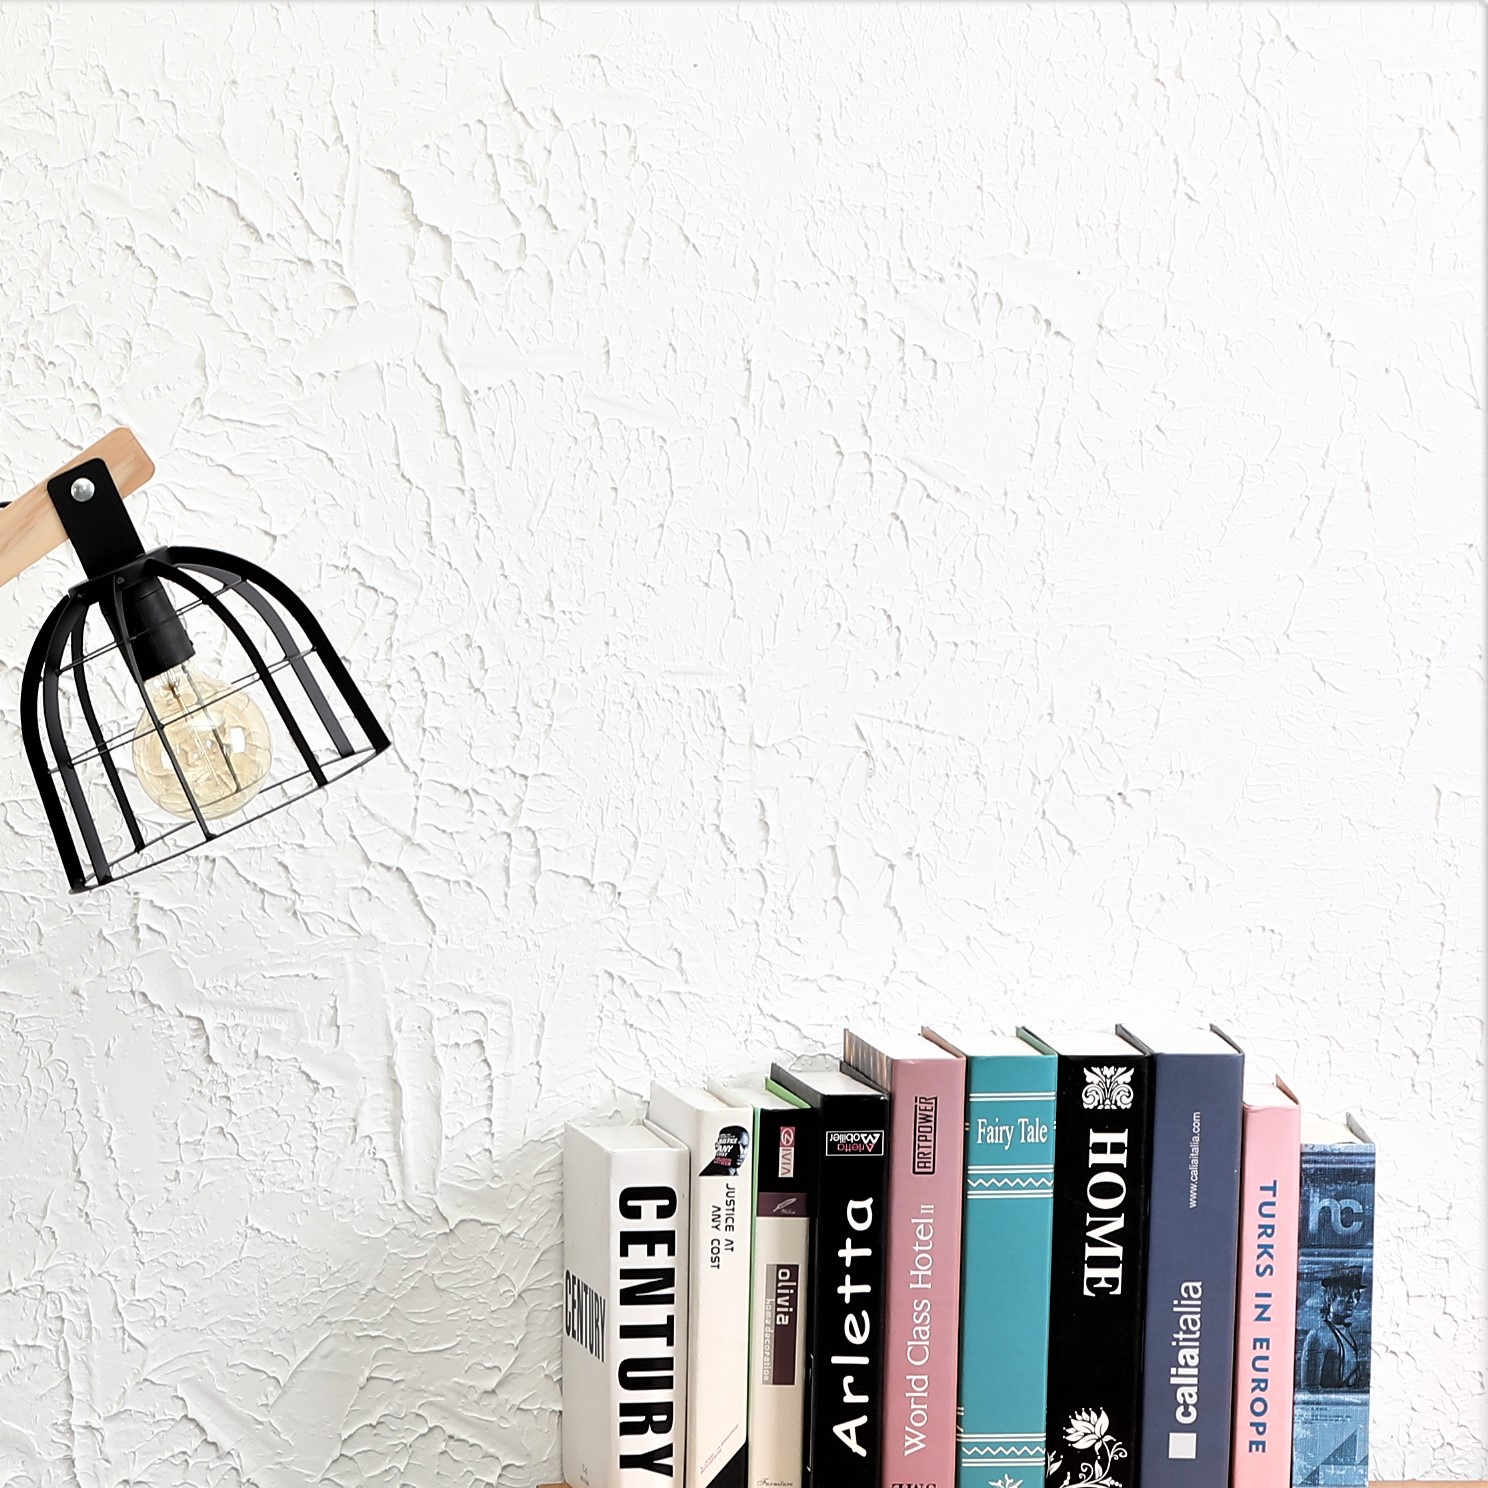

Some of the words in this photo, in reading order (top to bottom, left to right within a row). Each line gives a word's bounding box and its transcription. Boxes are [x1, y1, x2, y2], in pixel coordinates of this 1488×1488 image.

[916, 1095, 937, 1170] ARTPOWER
[976, 1117, 1015, 1151] Fairy
[1017, 1117, 1048, 1143] Tale
[1188, 1111, 1201, 1209] www.caliaitalia.com
[711, 1205, 722, 1232] ANY
[724, 1183, 736, 1233] JUSTICE
[1082, 1128, 1129, 1297] HOME
[1255, 1179, 1278, 1278] TURKS
[710, 1238, 721, 1270] COST
[724, 1238, 734, 1252] AT
[909, 1218, 934, 1290] Hotel
[565, 1269, 606, 1364] CENTURY
[617, 1185, 678, 1478] CENTURY
[764, 1298, 776, 1325] home
[775, 1268, 798, 1326] olivia
[831, 1197, 874, 1458] Arletta
[906, 1299, 931, 1366] Class
[1253, 1292, 1273, 1322] IN
[762, 1326, 774, 1382] decoration
[1169, 1281, 1203, 1424] caliaitalia
[904, 1374, 929, 1457] World
[1248, 1337, 1271, 1454] EUROPE
